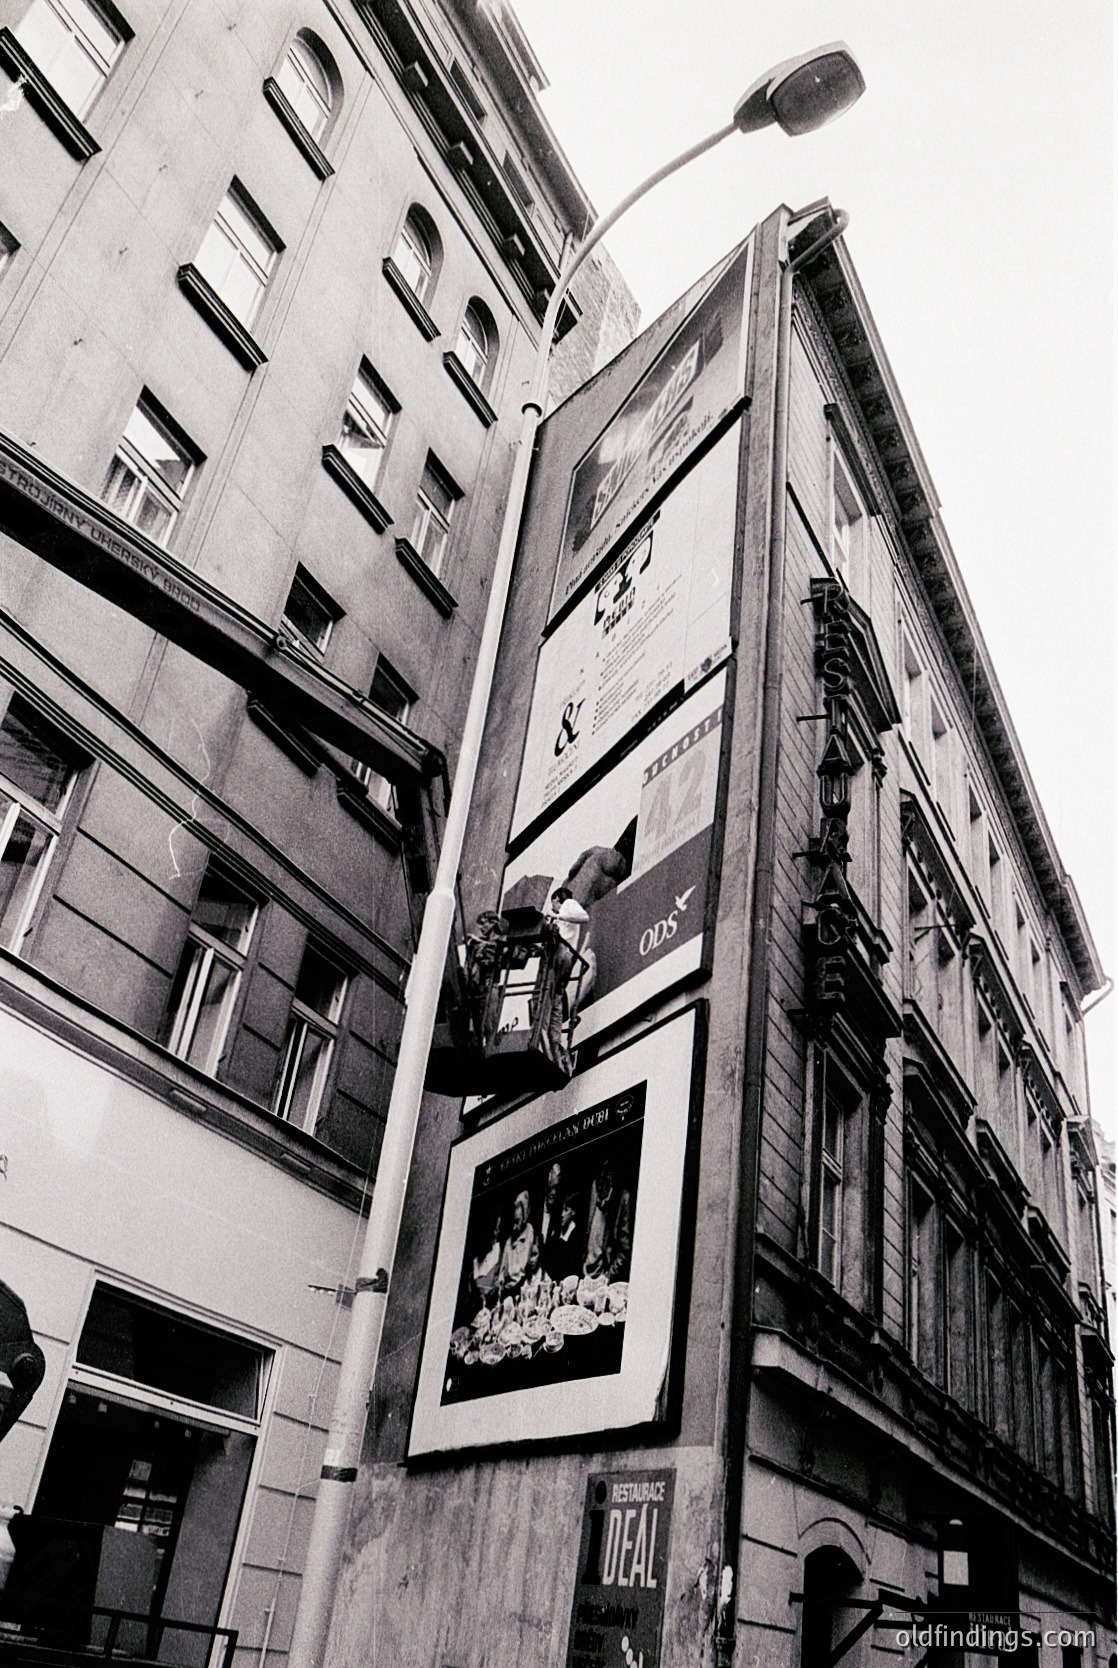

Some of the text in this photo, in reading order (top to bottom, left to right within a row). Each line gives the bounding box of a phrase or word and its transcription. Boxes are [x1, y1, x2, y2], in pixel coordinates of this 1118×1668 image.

[163, 577, 201, 612] BROD
[643, 750, 706, 840] 42
[639, 910, 678, 956] ODS
[611, 1481, 666, 1503] RESTAURACE
